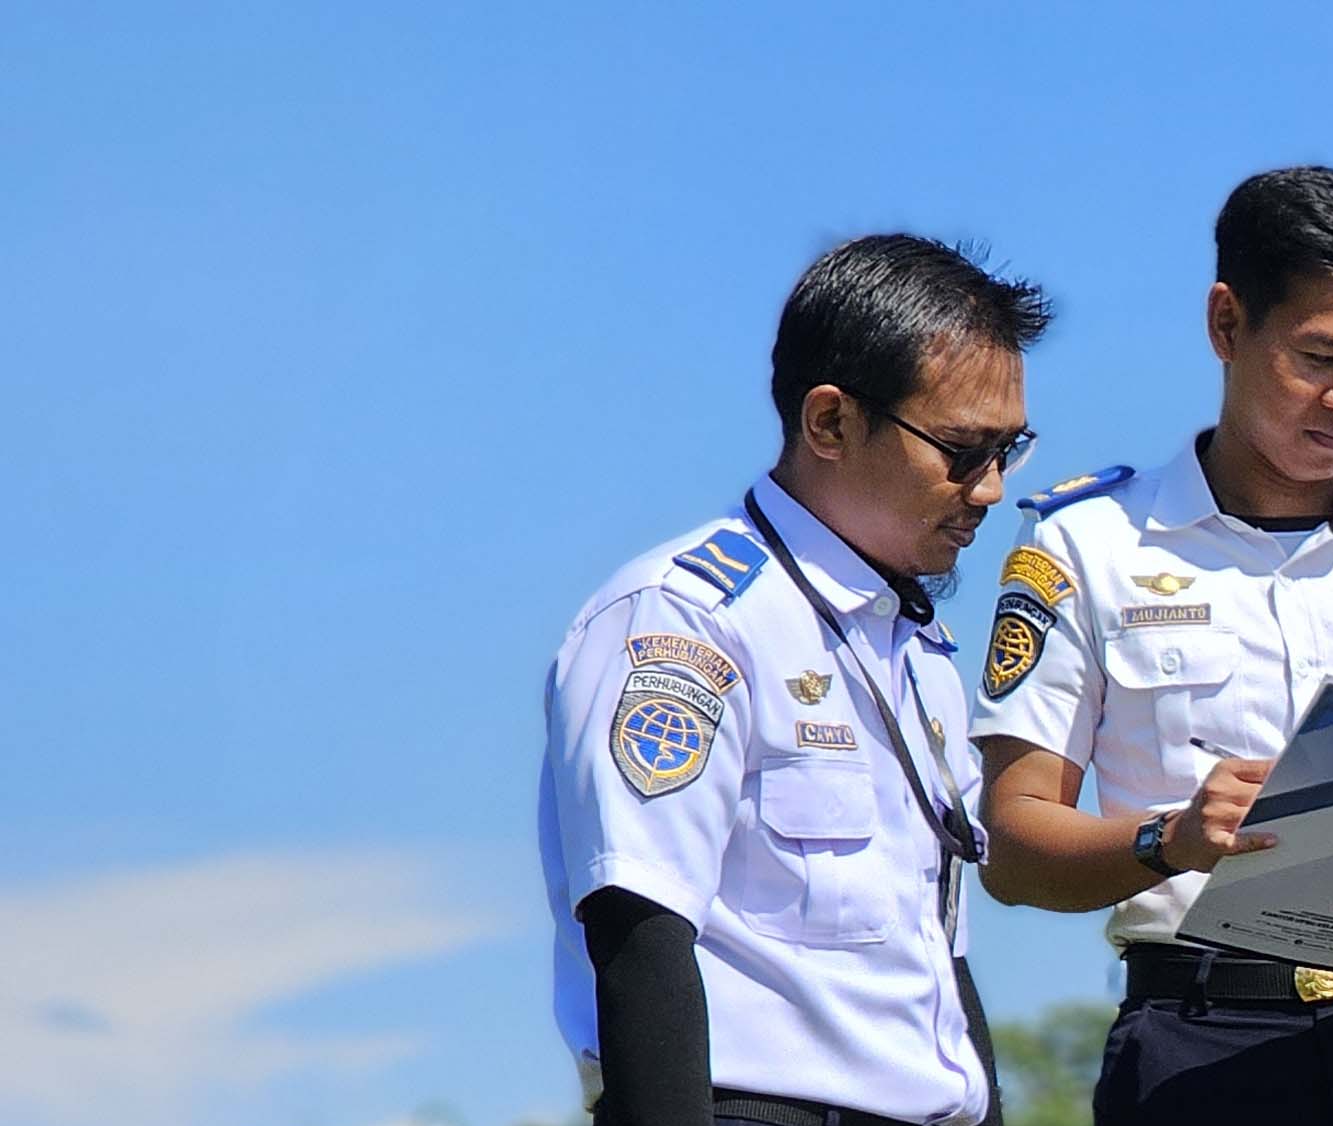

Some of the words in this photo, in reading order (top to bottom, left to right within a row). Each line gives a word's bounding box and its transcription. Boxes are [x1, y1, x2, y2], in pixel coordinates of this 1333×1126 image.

[1131, 608, 1207, 622] MUJIANTO
[638, 647, 727, 687] PERHUBUNGAN
[640, 637, 732, 675] KEMENTERIAN
[632, 675, 721, 716] PERHUBUNGAN
